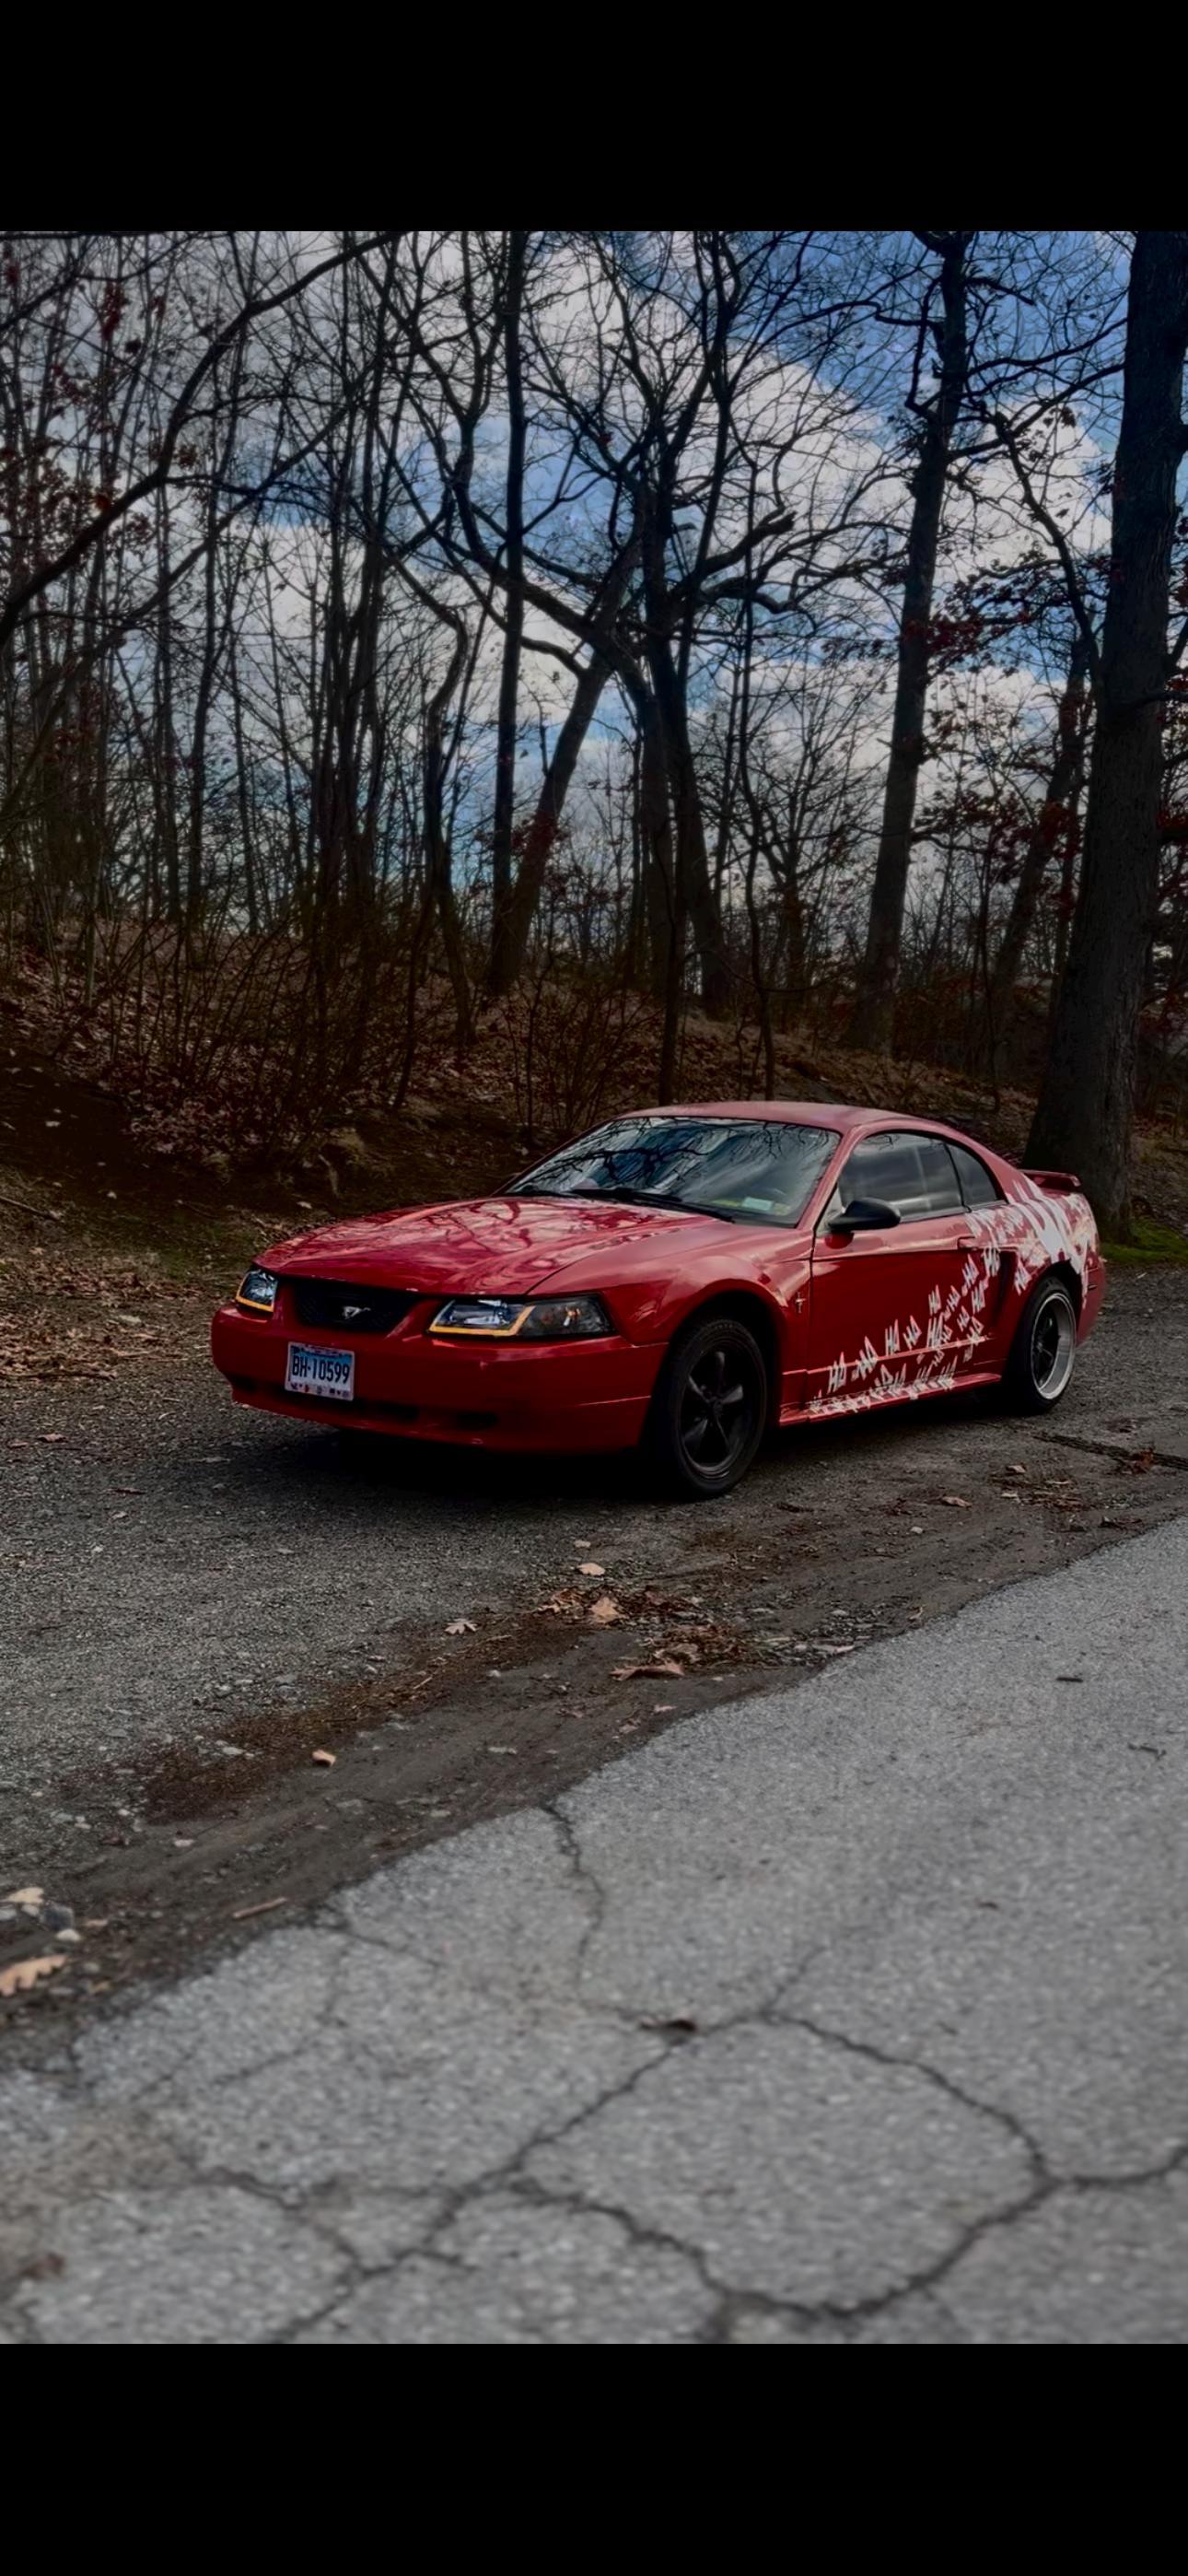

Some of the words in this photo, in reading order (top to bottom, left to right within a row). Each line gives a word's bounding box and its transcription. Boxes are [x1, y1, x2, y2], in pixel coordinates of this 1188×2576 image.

[928, 1284, 941, 1317] HA
[885, 1318, 901, 1357] HA
[903, 1315, 922, 1352] HA
[827, 1352, 847, 1395] HA
